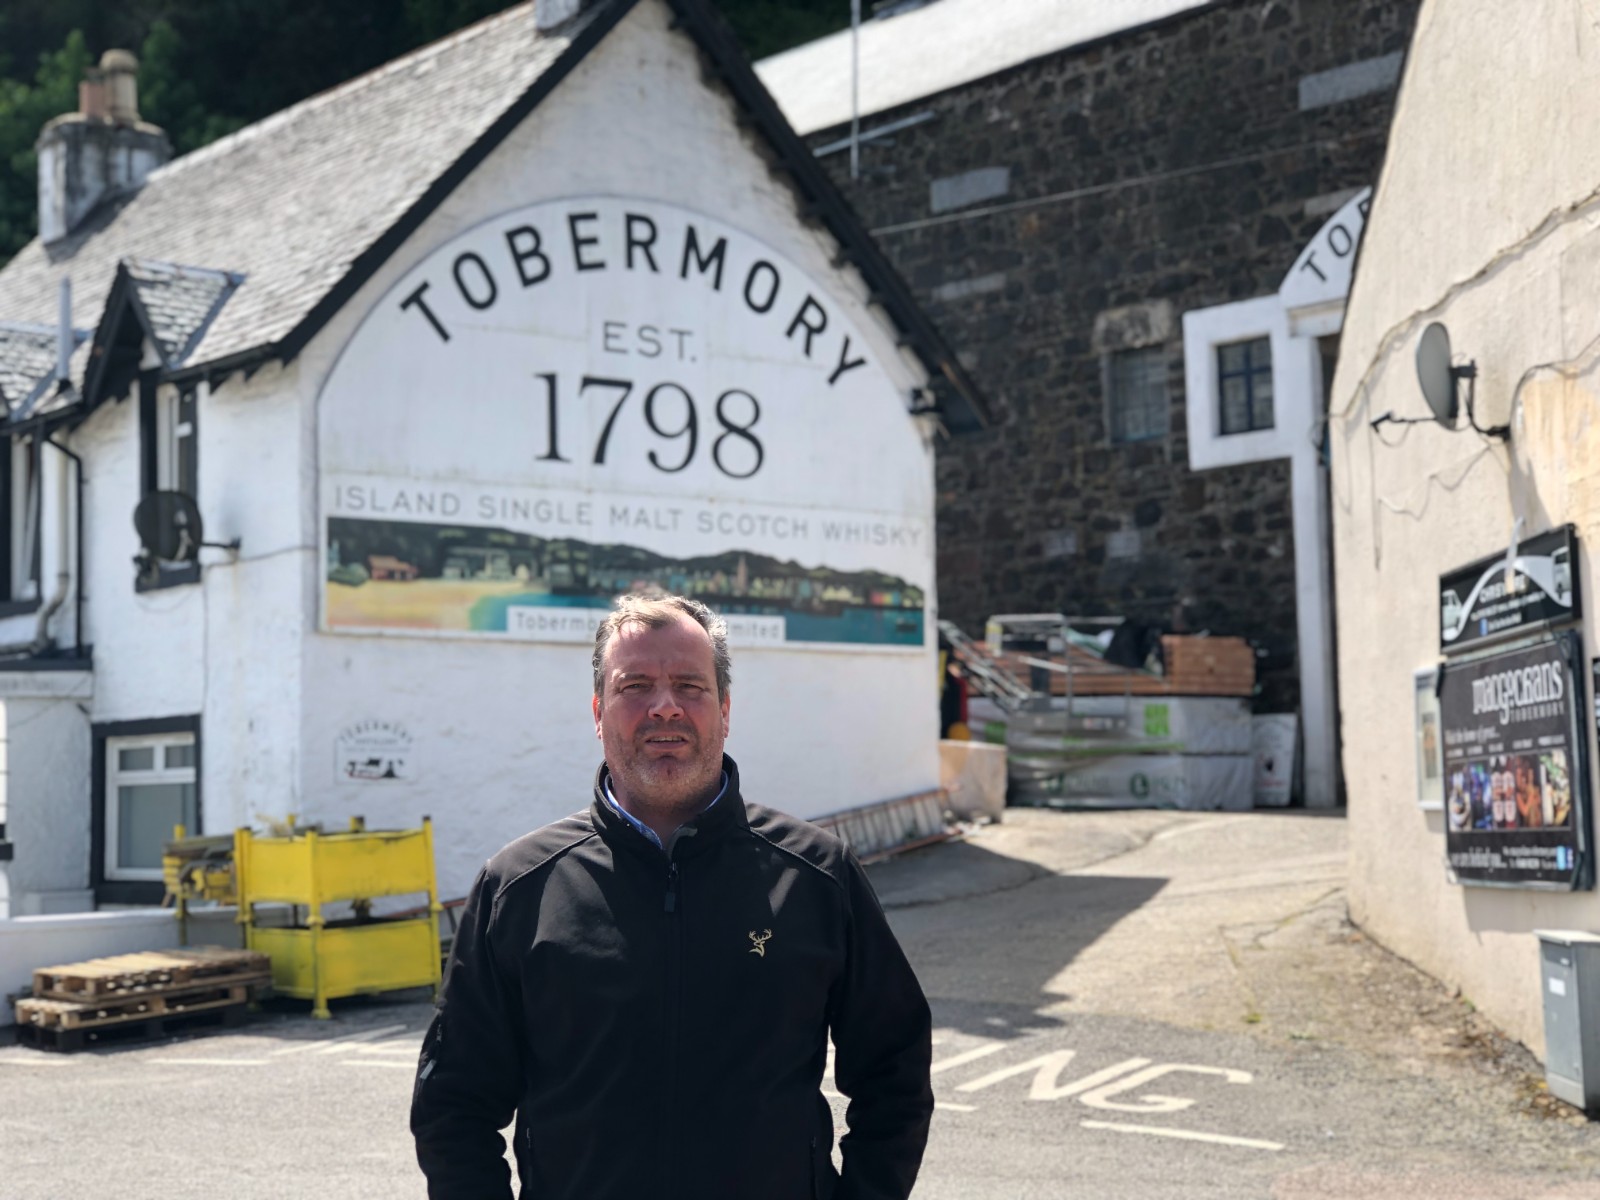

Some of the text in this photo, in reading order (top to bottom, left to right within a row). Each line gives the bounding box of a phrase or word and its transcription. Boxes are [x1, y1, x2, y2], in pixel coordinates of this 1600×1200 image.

[400, 213, 867, 386] TOBERMORY
[602, 321, 698, 362] EST.
[534, 372, 765, 479] 1798
[334, 485, 922, 547] ISLAND SINGLE MALT SCOTCH WHISKY
[516, 612, 597, 632] Tobermo
